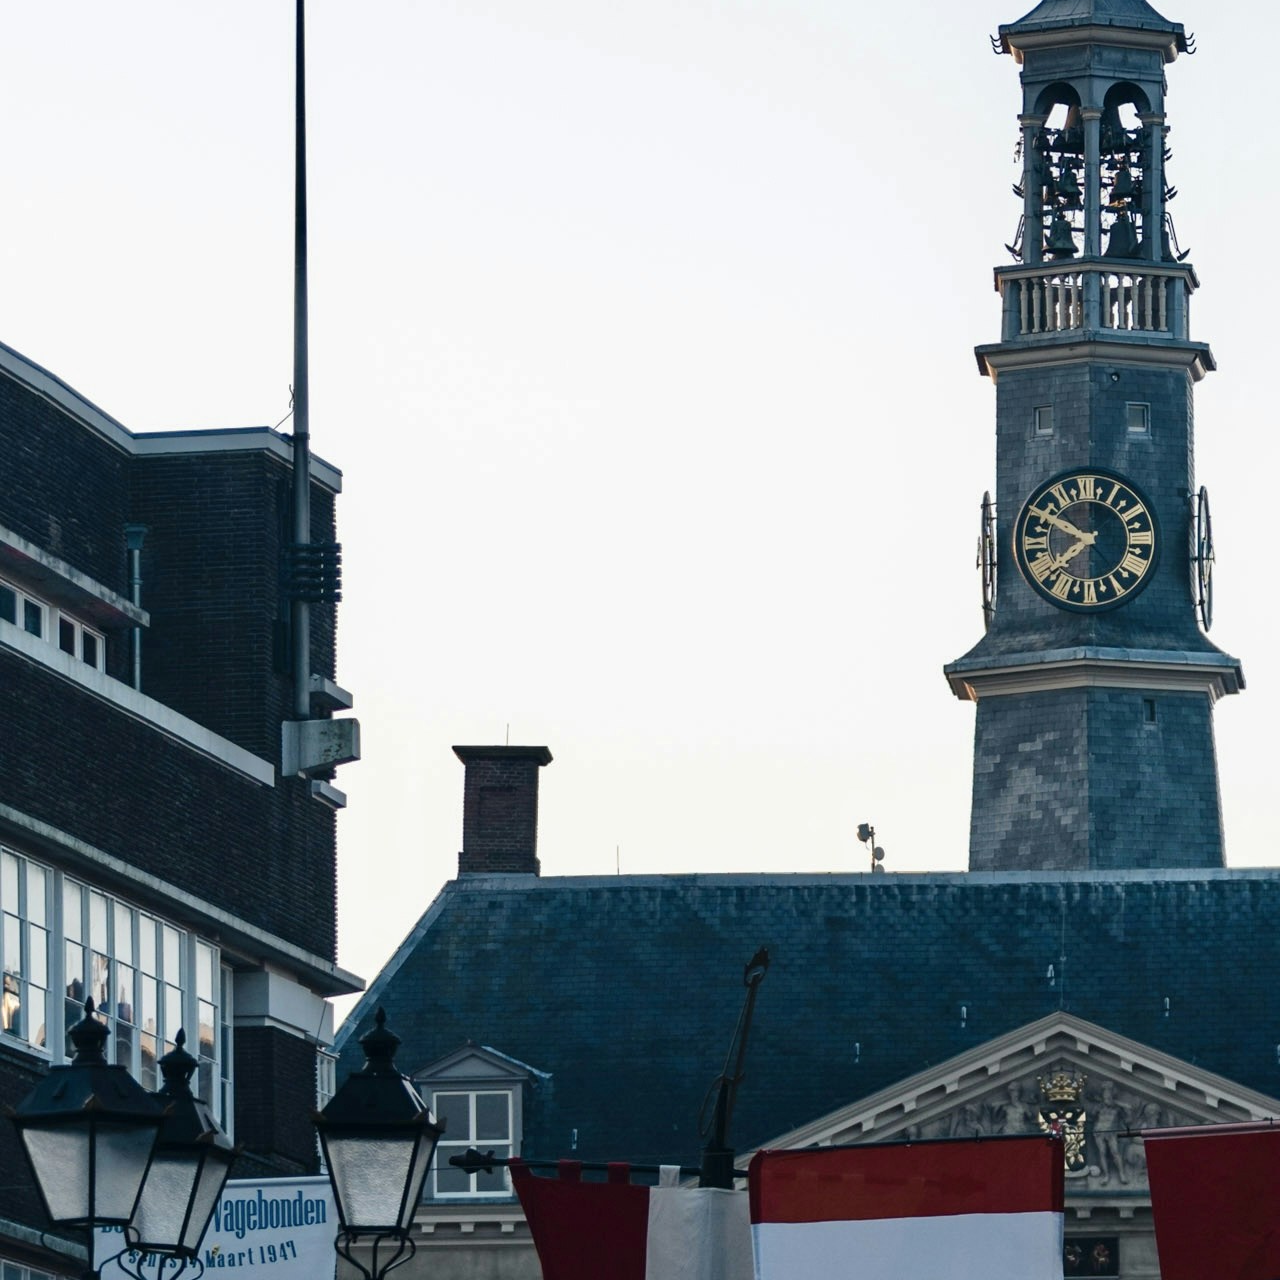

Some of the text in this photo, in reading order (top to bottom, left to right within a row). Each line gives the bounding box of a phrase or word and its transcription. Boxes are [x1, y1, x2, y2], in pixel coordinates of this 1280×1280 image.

[211, 1190, 327, 1239] Vagebonden
[206, 1248, 254, 1268] Maart
[260, 1240, 298, 1265] 1947
